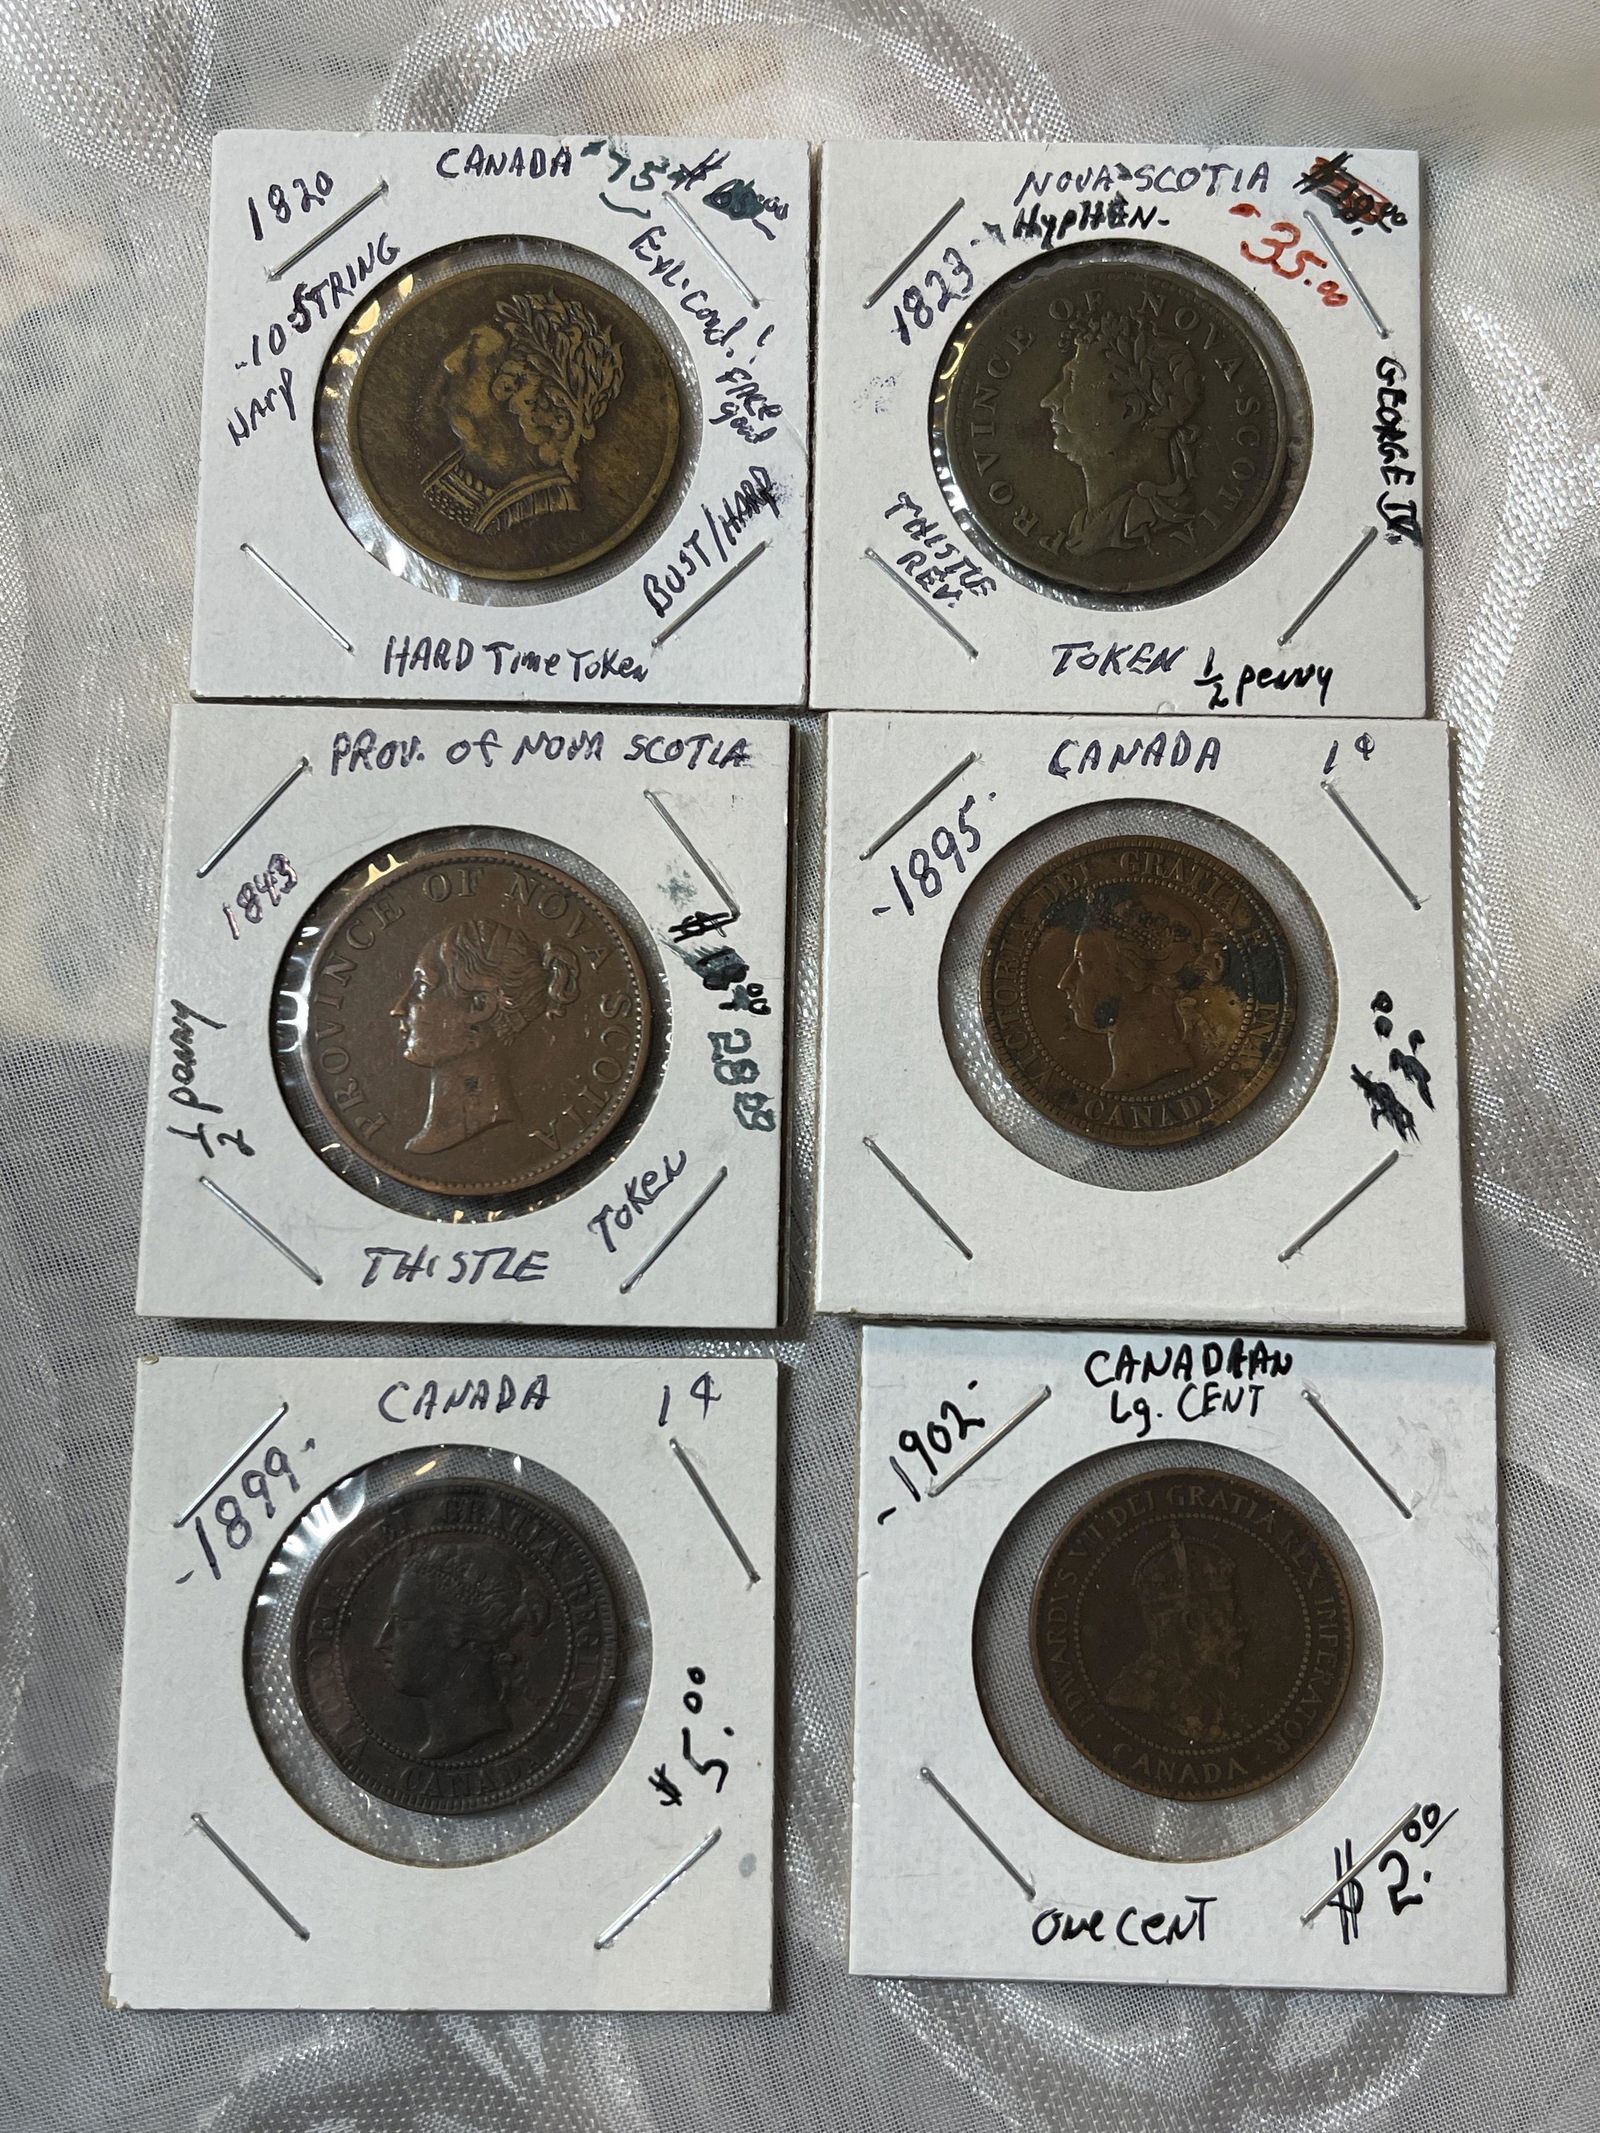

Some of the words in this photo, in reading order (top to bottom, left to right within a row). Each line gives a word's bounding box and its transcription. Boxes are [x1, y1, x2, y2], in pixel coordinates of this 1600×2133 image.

[436, 144, 573, 179] CANADA
[248, 169, 334, 241] 1820
[287, 231, 400, 334] STRING
[970, 324, 1067, 557] PROVINCE
[1047, 289, 1104, 322] OF
[1372, 355, 1416, 487] GEORGE
[384, 635, 474, 678] HARD
[482, 641, 560, 676] Time
[1051, 640, 1187, 677] TOKEN
[330, 728, 426, 776] PROV.
[622, 732, 752, 770] SCOTIA
[1047, 729, 1222, 779] CANADA
[222, 853, 298, 941] 1843
[421, 868, 485, 903] OF
[504, 870, 617, 973] NOVA
[315, 893, 407, 1142] PROVINCE
[528, 992, 633, 1152] SCOTIA
[1083, 1085, 1228, 1130] CANADA
[361, 1244, 550, 1288] THISTLE
[377, 1373, 551, 1424] CANADA
[1176, 1380, 1266, 1423] CENT
[1165, 1484, 1276, 1533] GRATIA
[1112, 1742, 1249, 1785] CANADA
